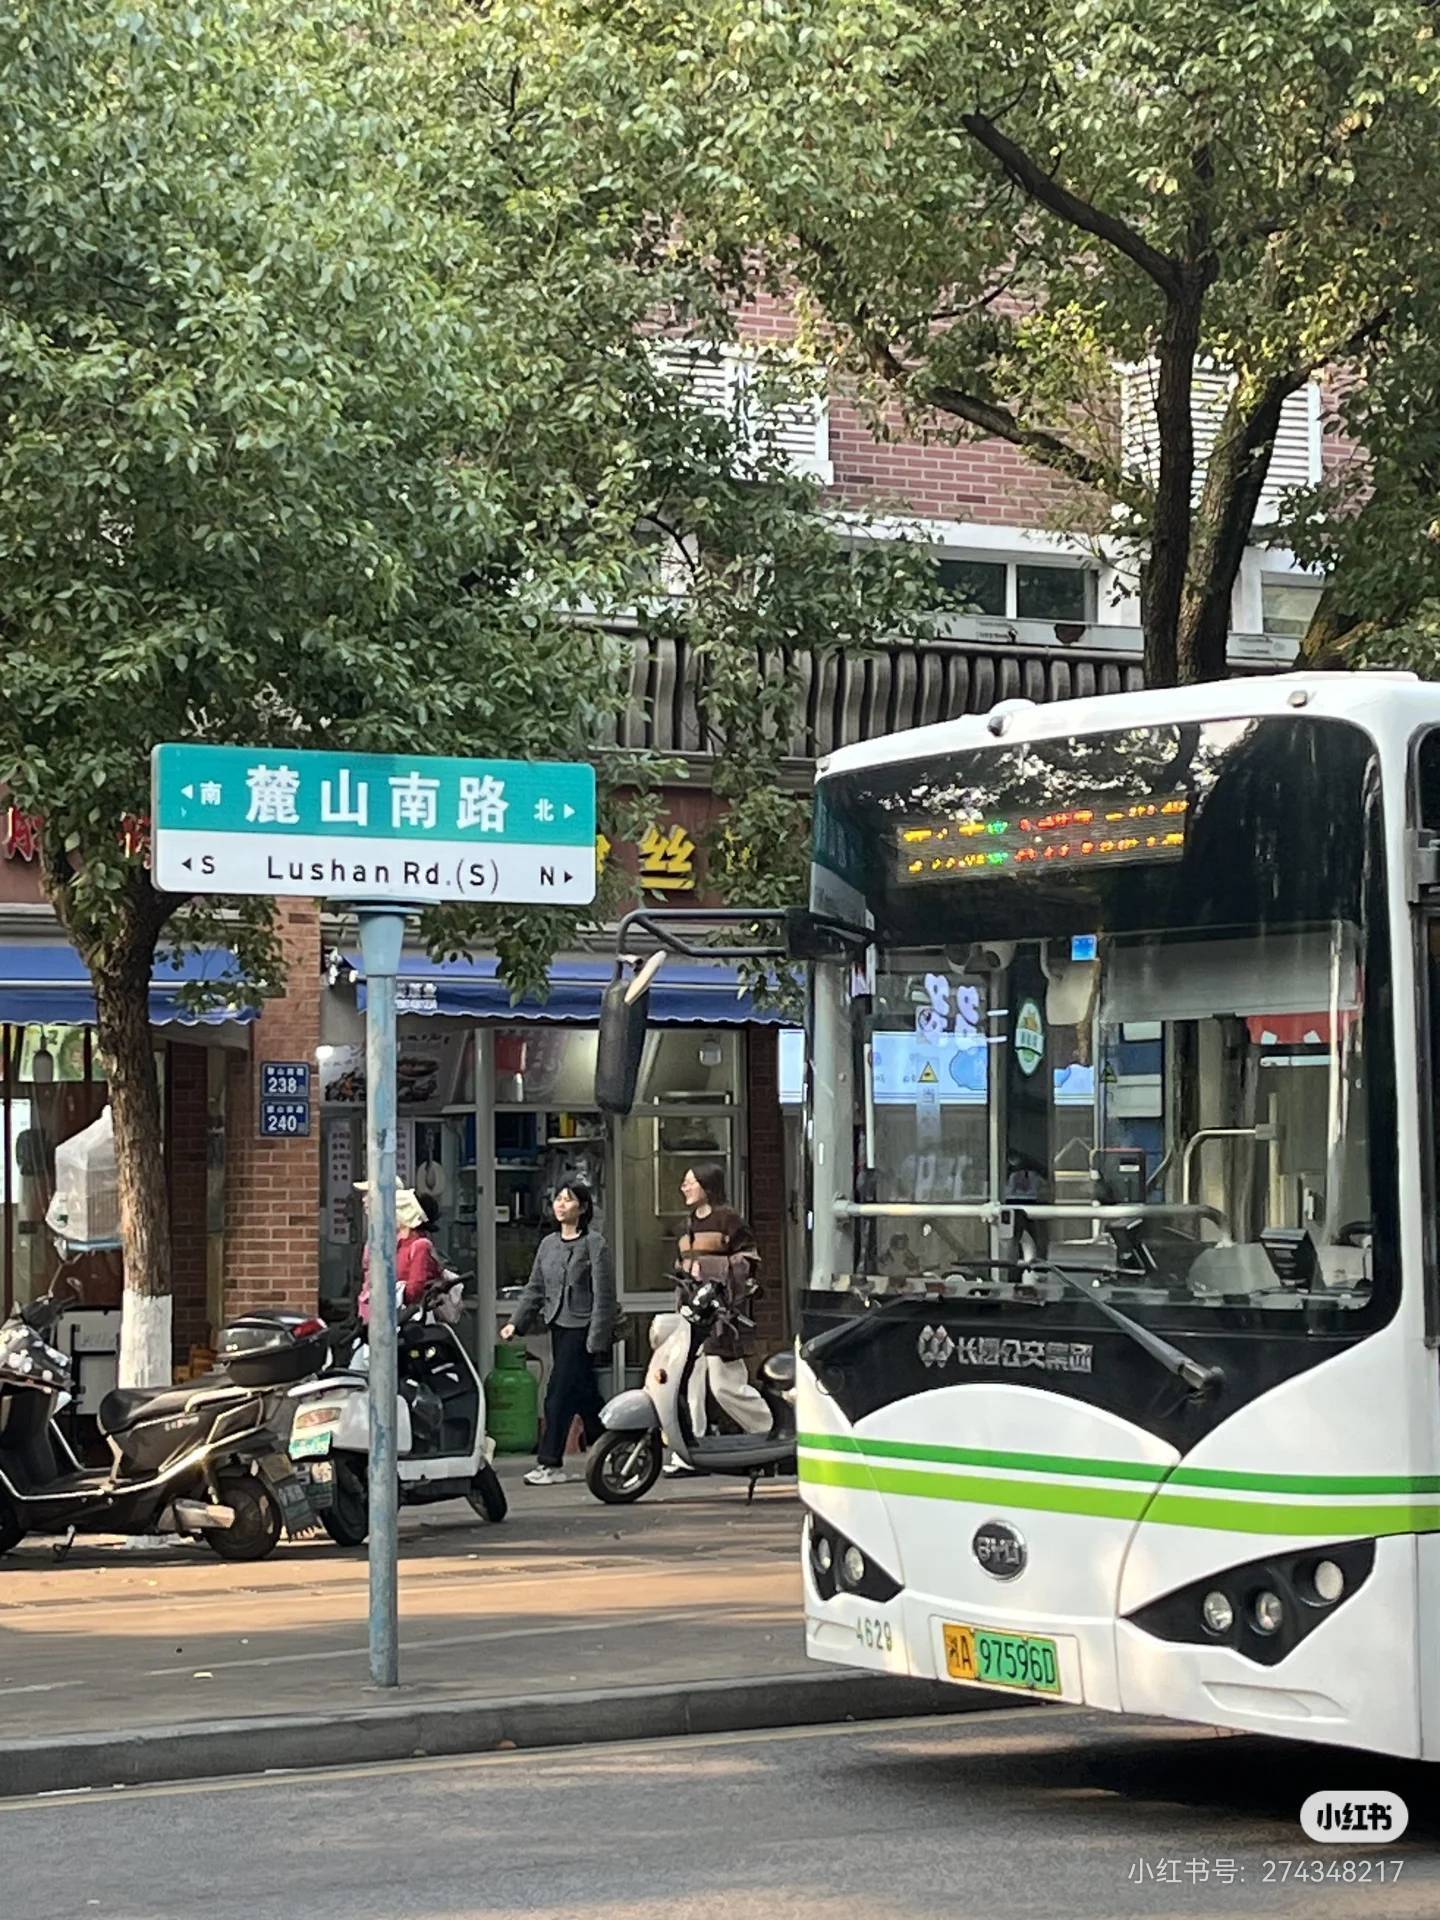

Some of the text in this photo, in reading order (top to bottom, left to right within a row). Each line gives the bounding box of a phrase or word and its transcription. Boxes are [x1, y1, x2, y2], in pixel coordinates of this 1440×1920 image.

[200, 780, 222, 805] 南
[245, 764, 510, 833] 麓山南路
[534, 798, 554, 822] 北
[201, 855, 215, 875] S
[267, 855, 389, 883] Lushan
[540, 866, 555, 886] N
[268, 1076, 297, 1094] 238
[268, 1115, 297, 1132] 240
[856, 1616, 893, 1652] 4629
